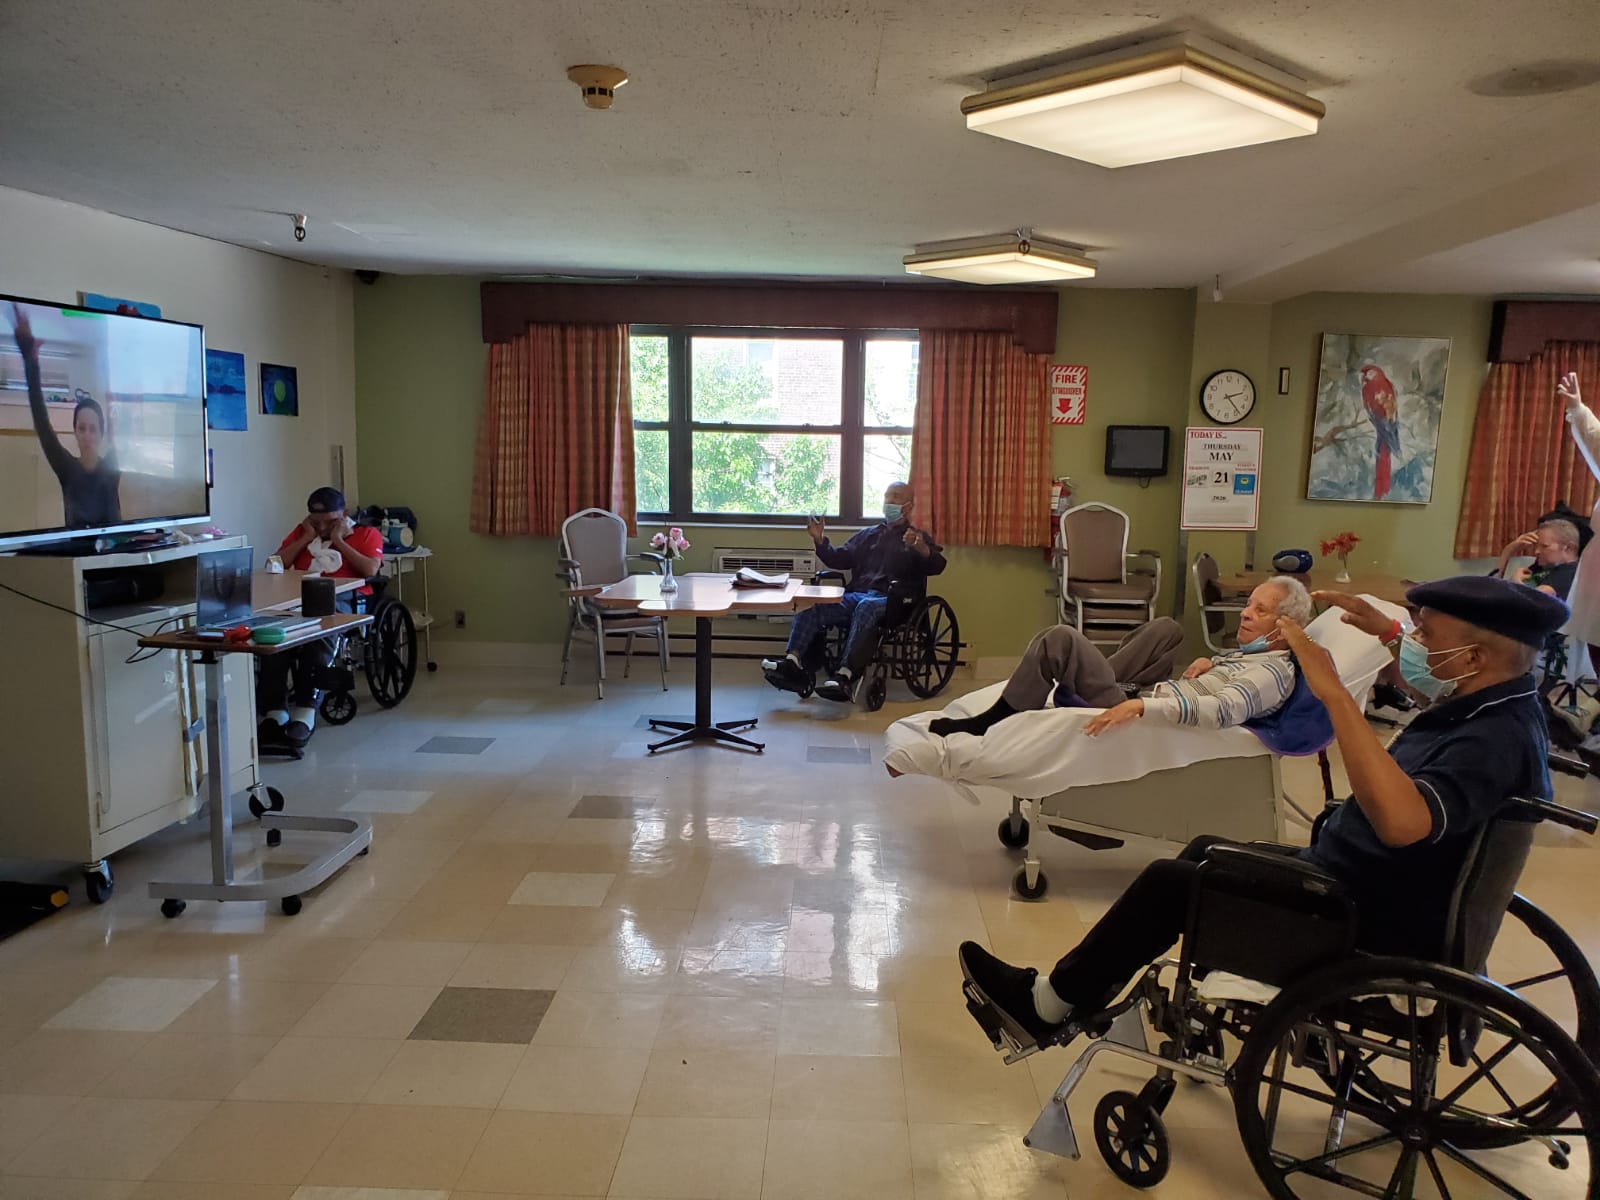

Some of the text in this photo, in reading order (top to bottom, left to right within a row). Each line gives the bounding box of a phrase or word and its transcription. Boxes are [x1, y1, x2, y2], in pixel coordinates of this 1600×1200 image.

[1055, 374, 1078, 384] FIRE
[1226, 375, 1233, 383] 12
[1190, 431, 1213, 439] TODAY
[1203, 443, 1241, 451] THURSDAY
[1209, 452, 1234, 462] MAY
[1213, 471, 1229, 484] 21
